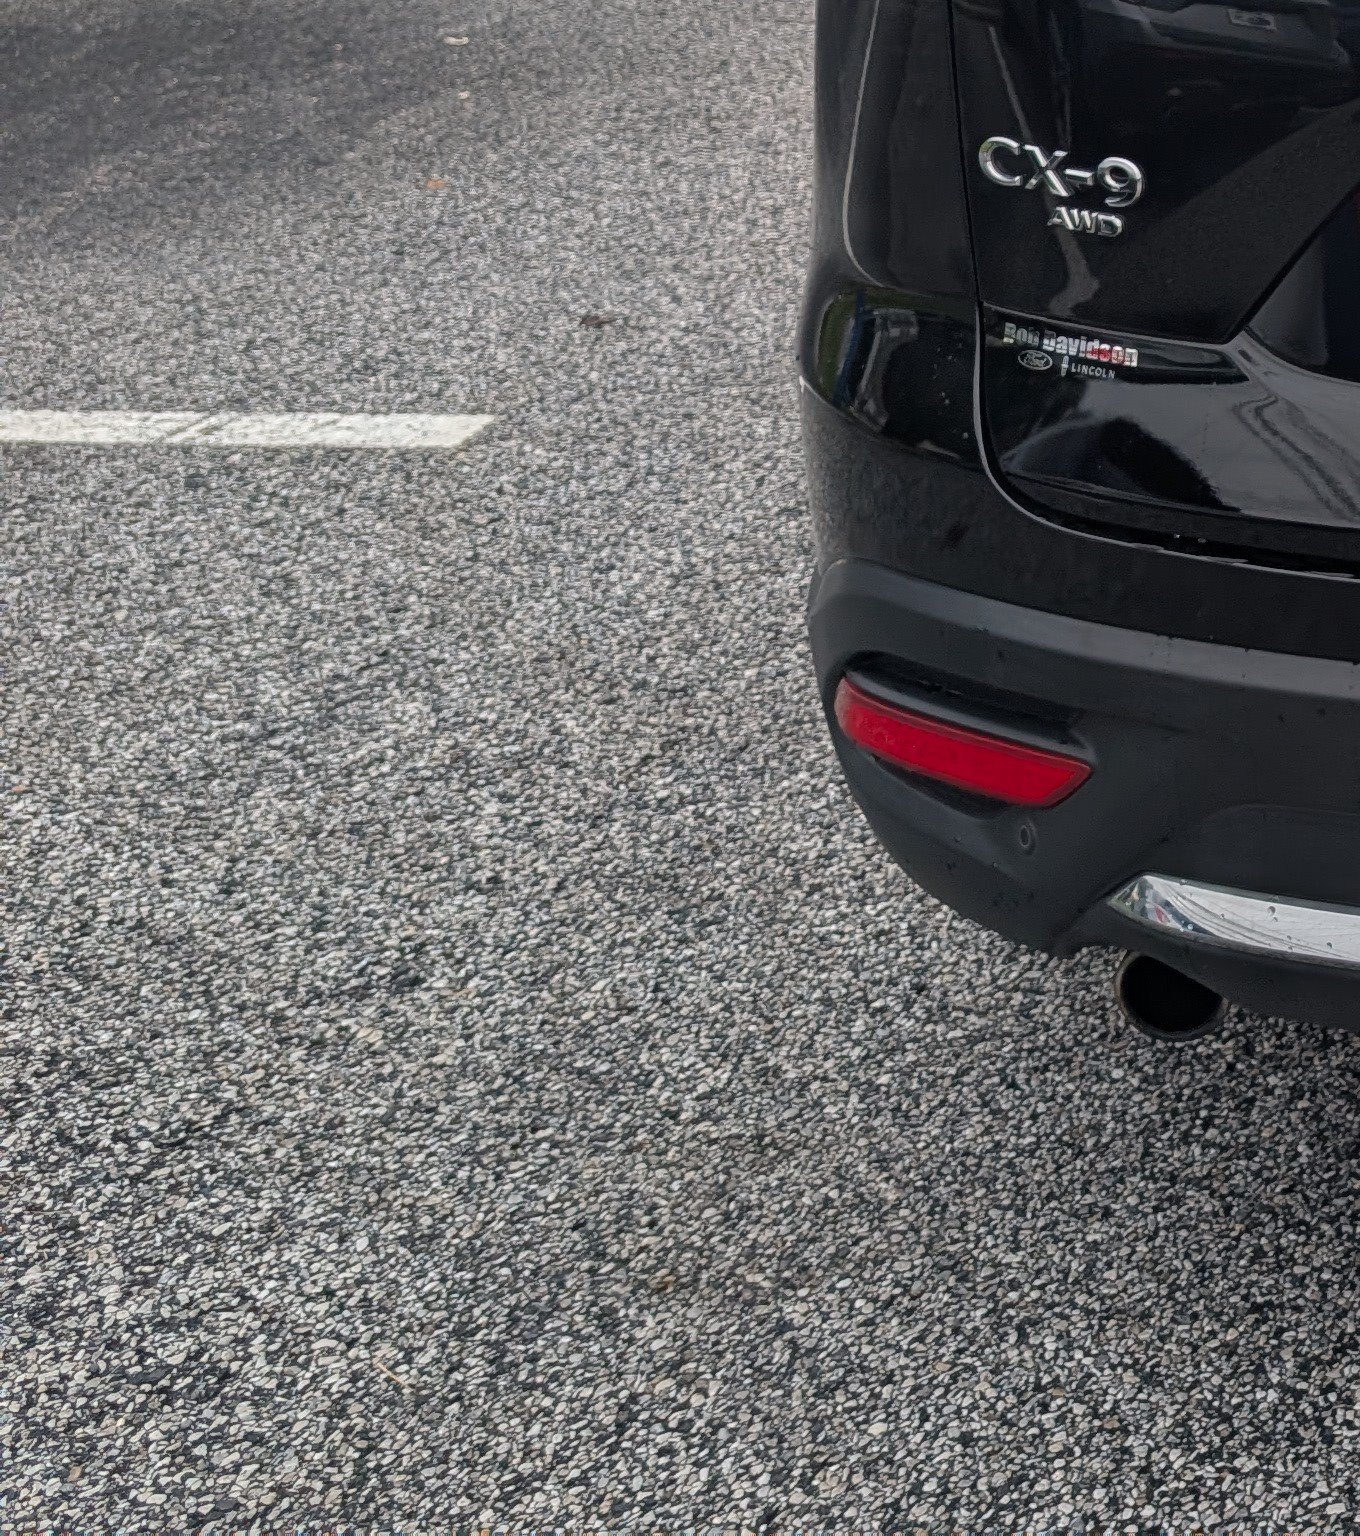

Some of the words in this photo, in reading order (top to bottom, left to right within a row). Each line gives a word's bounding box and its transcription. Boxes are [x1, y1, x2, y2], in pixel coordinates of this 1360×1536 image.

[978, 136, 1145, 208] CX-9
[1047, 206, 1124, 238] AWD
[1003, 321, 1040, 349] Bob
[1042, 329, 1139, 368] Davidson
[1071, 362, 1116, 379] LINCOLN
